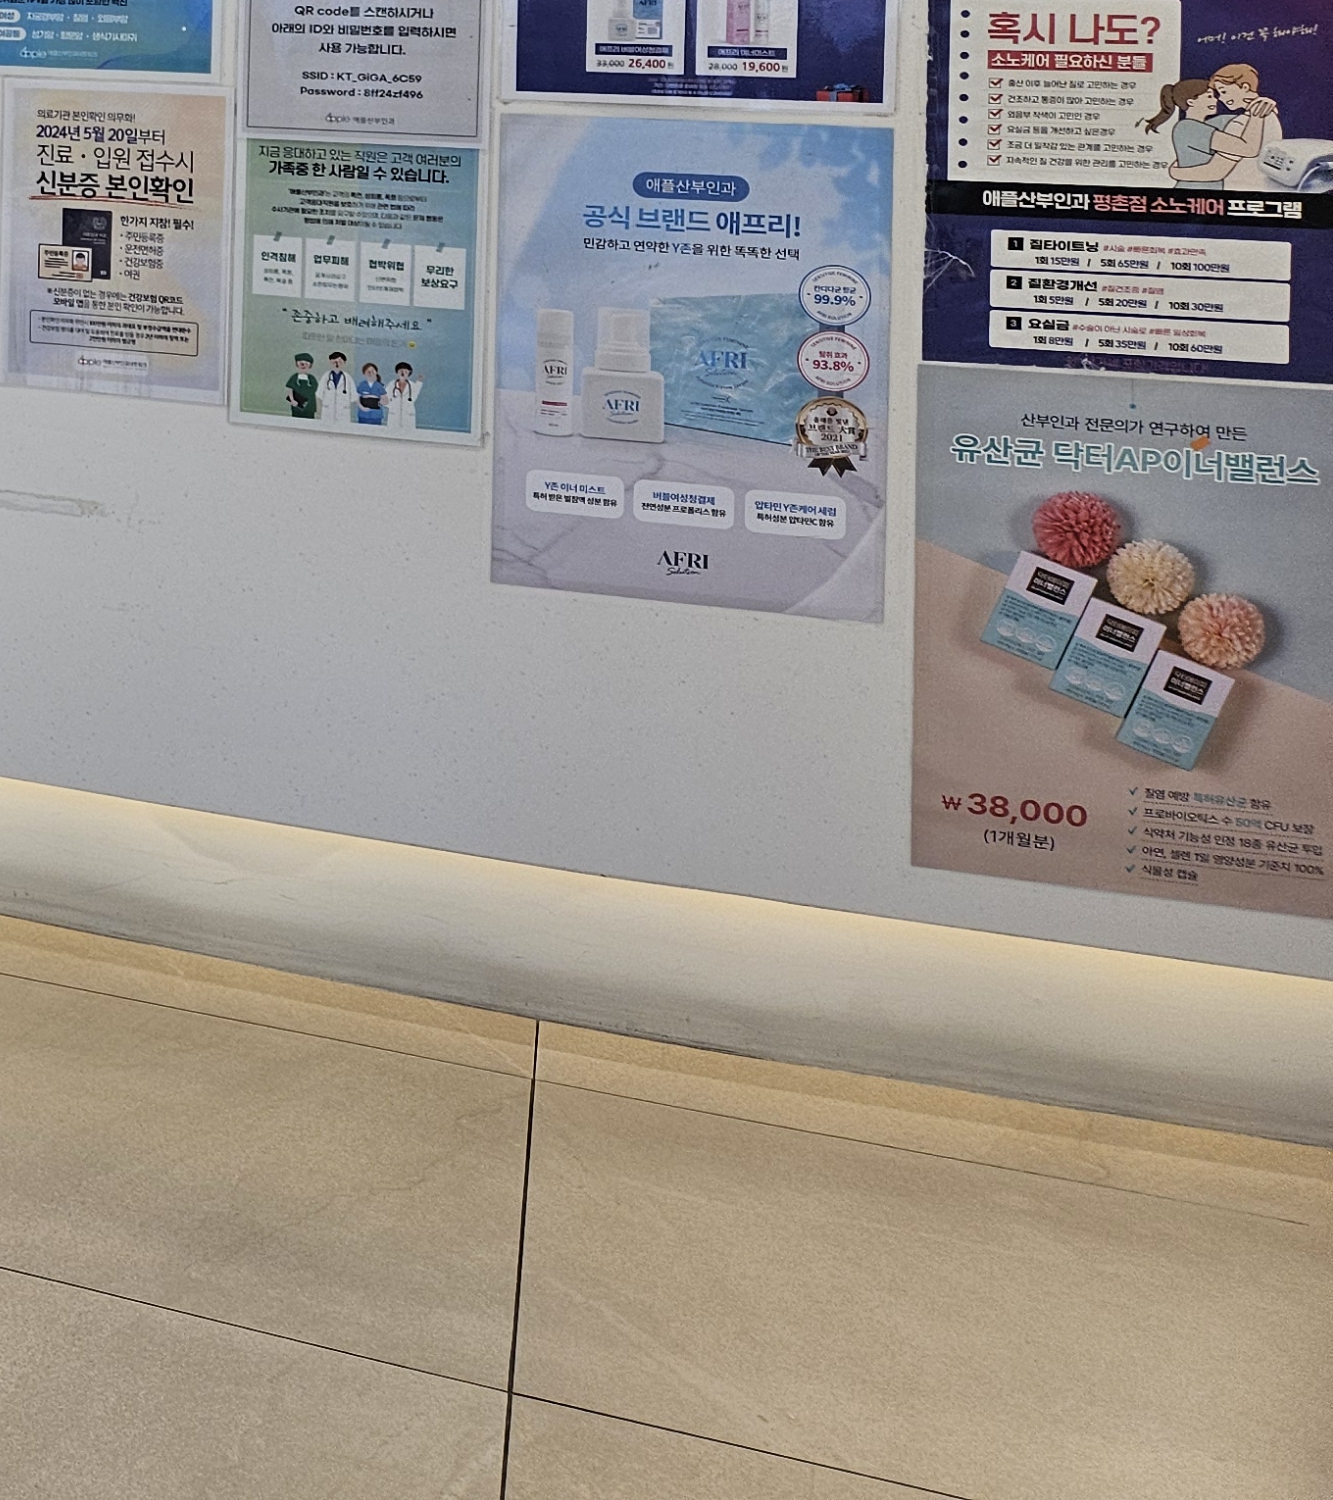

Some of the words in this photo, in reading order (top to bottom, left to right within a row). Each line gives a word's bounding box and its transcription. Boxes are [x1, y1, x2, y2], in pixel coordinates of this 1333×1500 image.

[398, 26, 457, 38] 입력하시면
[987, 12, 1056, 45] 혹시
[1069, 13, 1161, 45] 나도?
[345, 43, 406, 55] 가능합니다.
[628, 58, 666, 69] 26,400
[742, 61, 780, 72] 19,600
[991, 53, 1050, 68] 소노케어
[1054, 53, 1113, 69] 필요하신
[1117, 55, 1147, 70] 분들
[302, 71, 328, 81] SSID
[300, 87, 355, 97] Password
[36, 124, 81, 142] 2024년
[83, 126, 105, 143] 5월
[108, 128, 166, 146] 20일부터
[37, 143, 74, 166] 진료
[93, 147, 131, 171] 입원
[136, 148, 194, 174] 접수시
[354, 150, 388, 164] 직원은
[391, 152, 413, 166] 고객
[415, 154, 462, 168] 여러분의
[269, 160, 309, 176] 가족중
[313, 163, 326, 178] 한
[329, 165, 369, 180] 사람일
[373, 167, 387, 180] 수
[391, 168, 449, 184] 있습니다.
[36, 170, 100, 199] 신분증
[105, 173, 194, 204] 본인확인
[646, 178, 737, 196] 애플산부인과
[983, 190, 1090, 211] 애플산부인과
[1093, 192, 1148, 214] 평촌점
[1149, 196, 1225, 216] 소노케어
[1227, 199, 1303, 220] 프로그램
[120, 216, 148, 227] 한가지
[583, 205, 631, 230] 공식
[636, 207, 711, 233] 브랜드
[716, 211, 801, 238] 애프리!
[584, 237, 631, 251] 민감하고
[775, 247, 800, 261] 선택
[313, 255, 350, 267] 업무피해
[124, 269, 140, 280] 여권
[813, 293, 857, 307] 99.9%
[812, 359, 855, 373] 93.8%
[1021, 413, 1080, 432] 산부인과
[1084, 416, 1145, 435] 전문의가
[1215, 425, 1249, 442] 만든
[949, 434, 1045, 470] 유산균
[1051, 442, 1322, 487] 닥터AP이너밸런스
[657, 550, 709, 570] AFRI
[1143, 808, 1219, 825] 프로바이오틱스
[983, 829, 1056, 852] (1개월분)
[1144, 826, 1176, 840] 식약처
